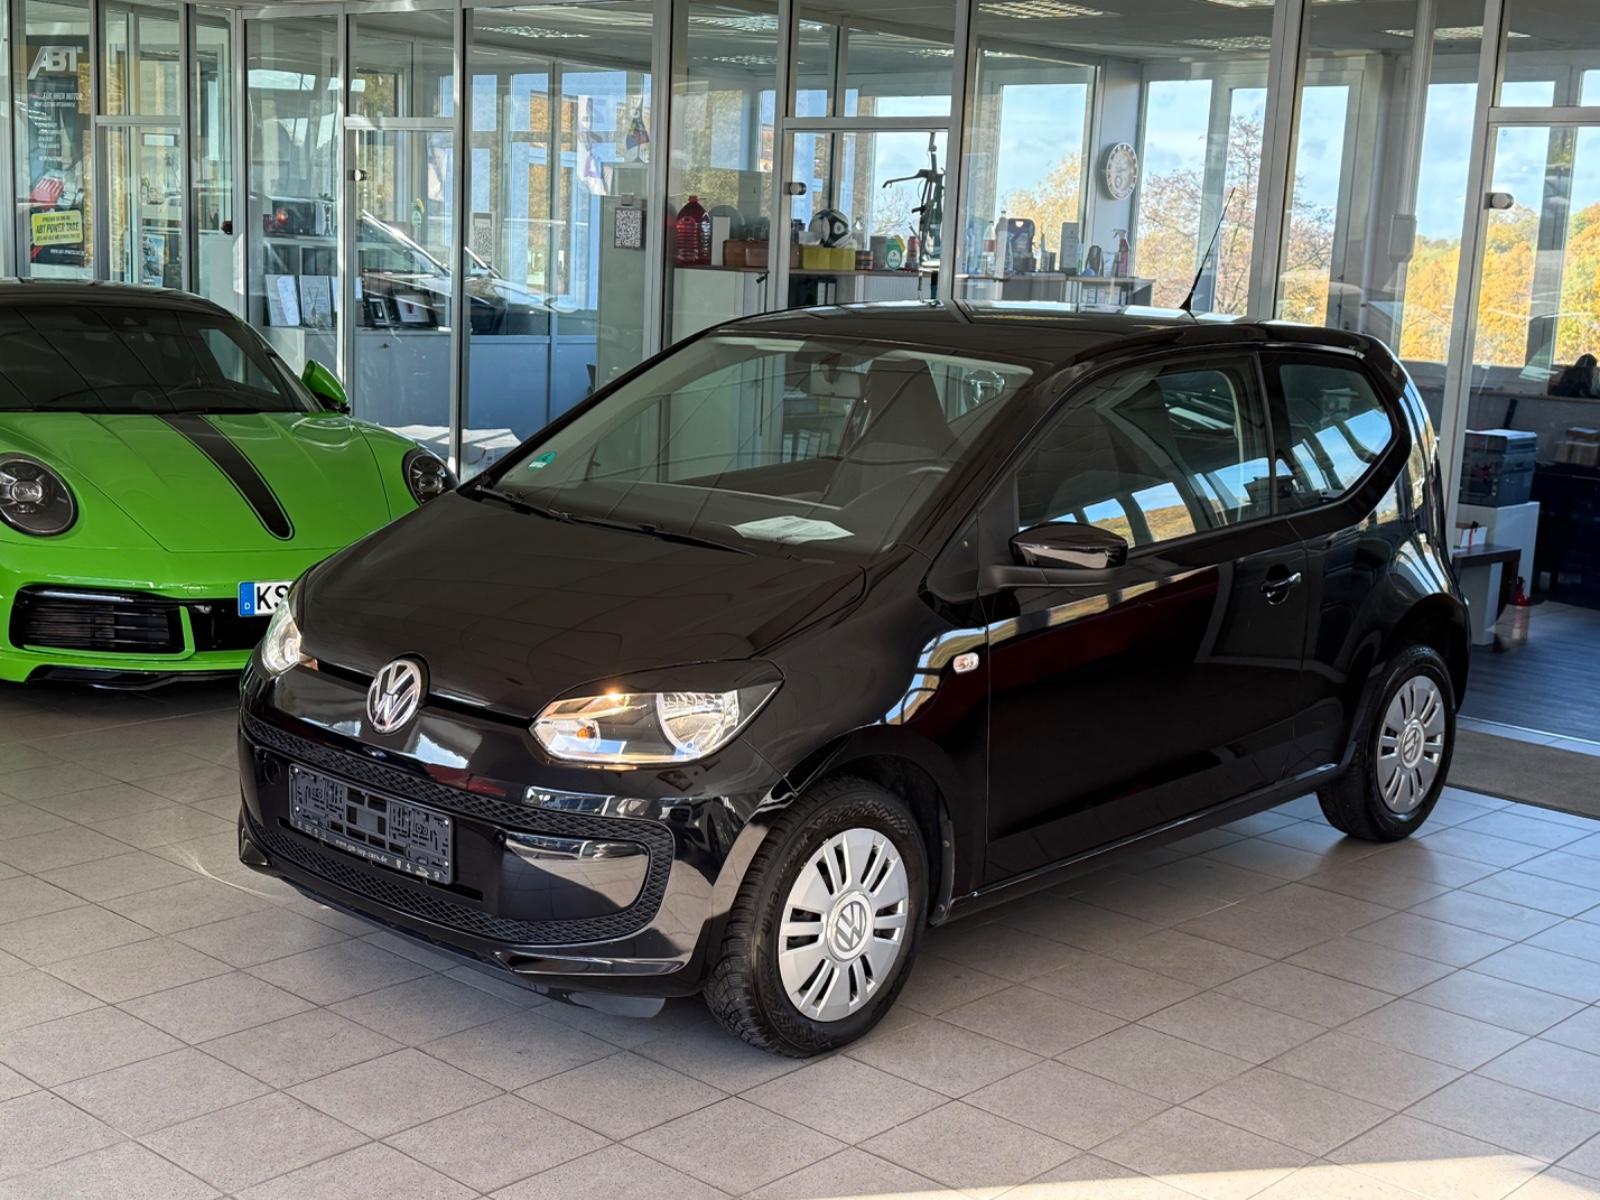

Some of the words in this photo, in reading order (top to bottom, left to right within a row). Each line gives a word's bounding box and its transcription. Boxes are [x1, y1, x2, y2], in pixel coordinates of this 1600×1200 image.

[27, 45, 83, 80] ABT
[244, 602, 251, 610] D
[367, 660, 421, 730] VW
